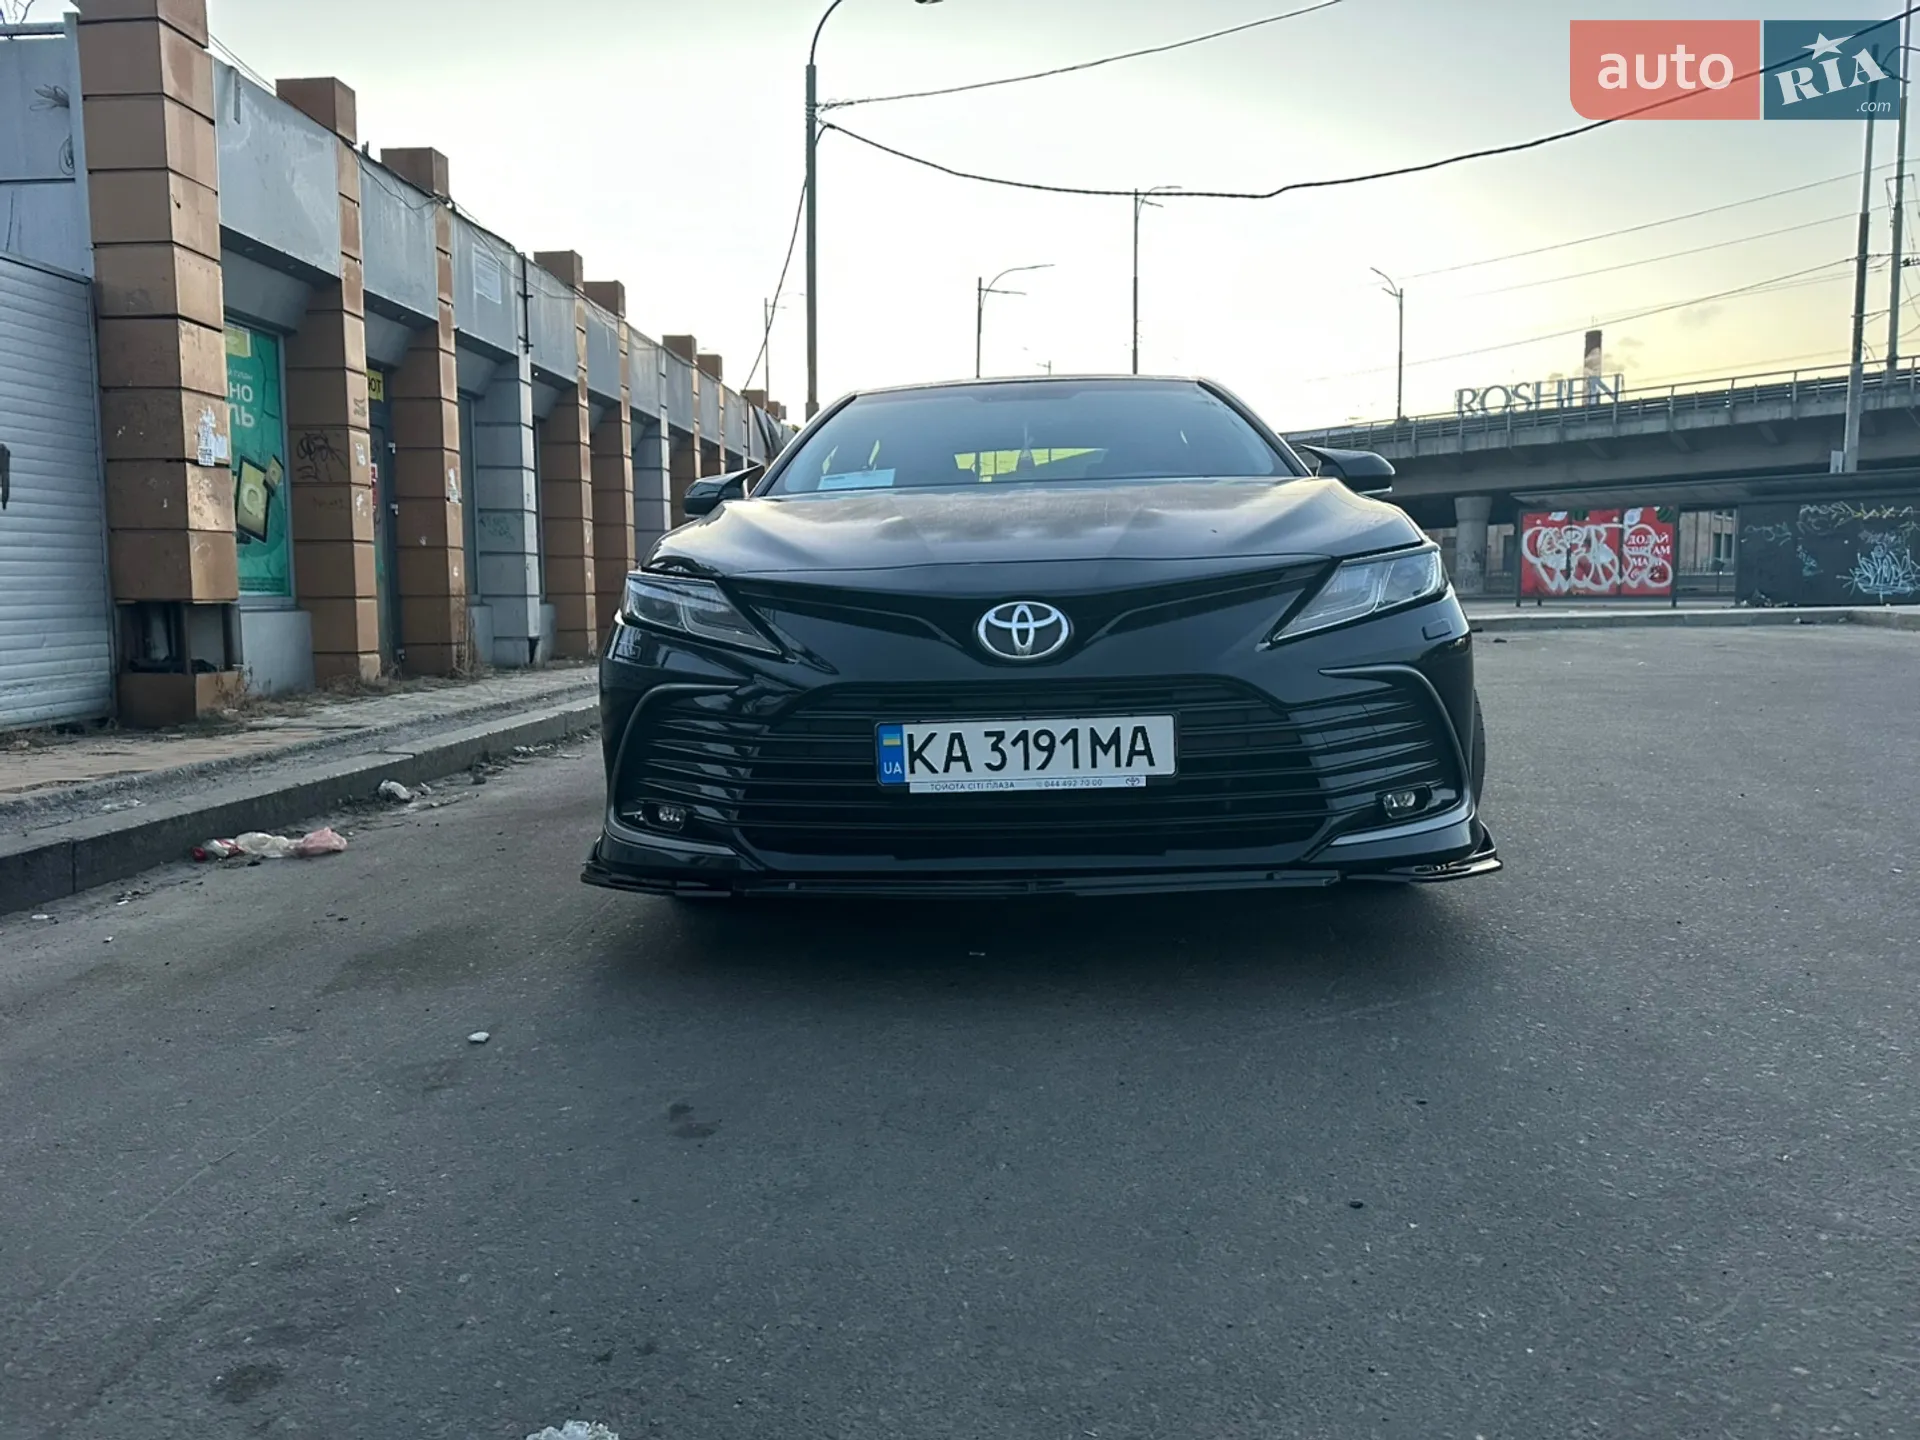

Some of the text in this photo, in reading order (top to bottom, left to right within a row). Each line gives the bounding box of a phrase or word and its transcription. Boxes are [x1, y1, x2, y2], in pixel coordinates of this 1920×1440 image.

[907, 725, 1156, 774] KA 3191 MA
[884, 761, 903, 775] UA
